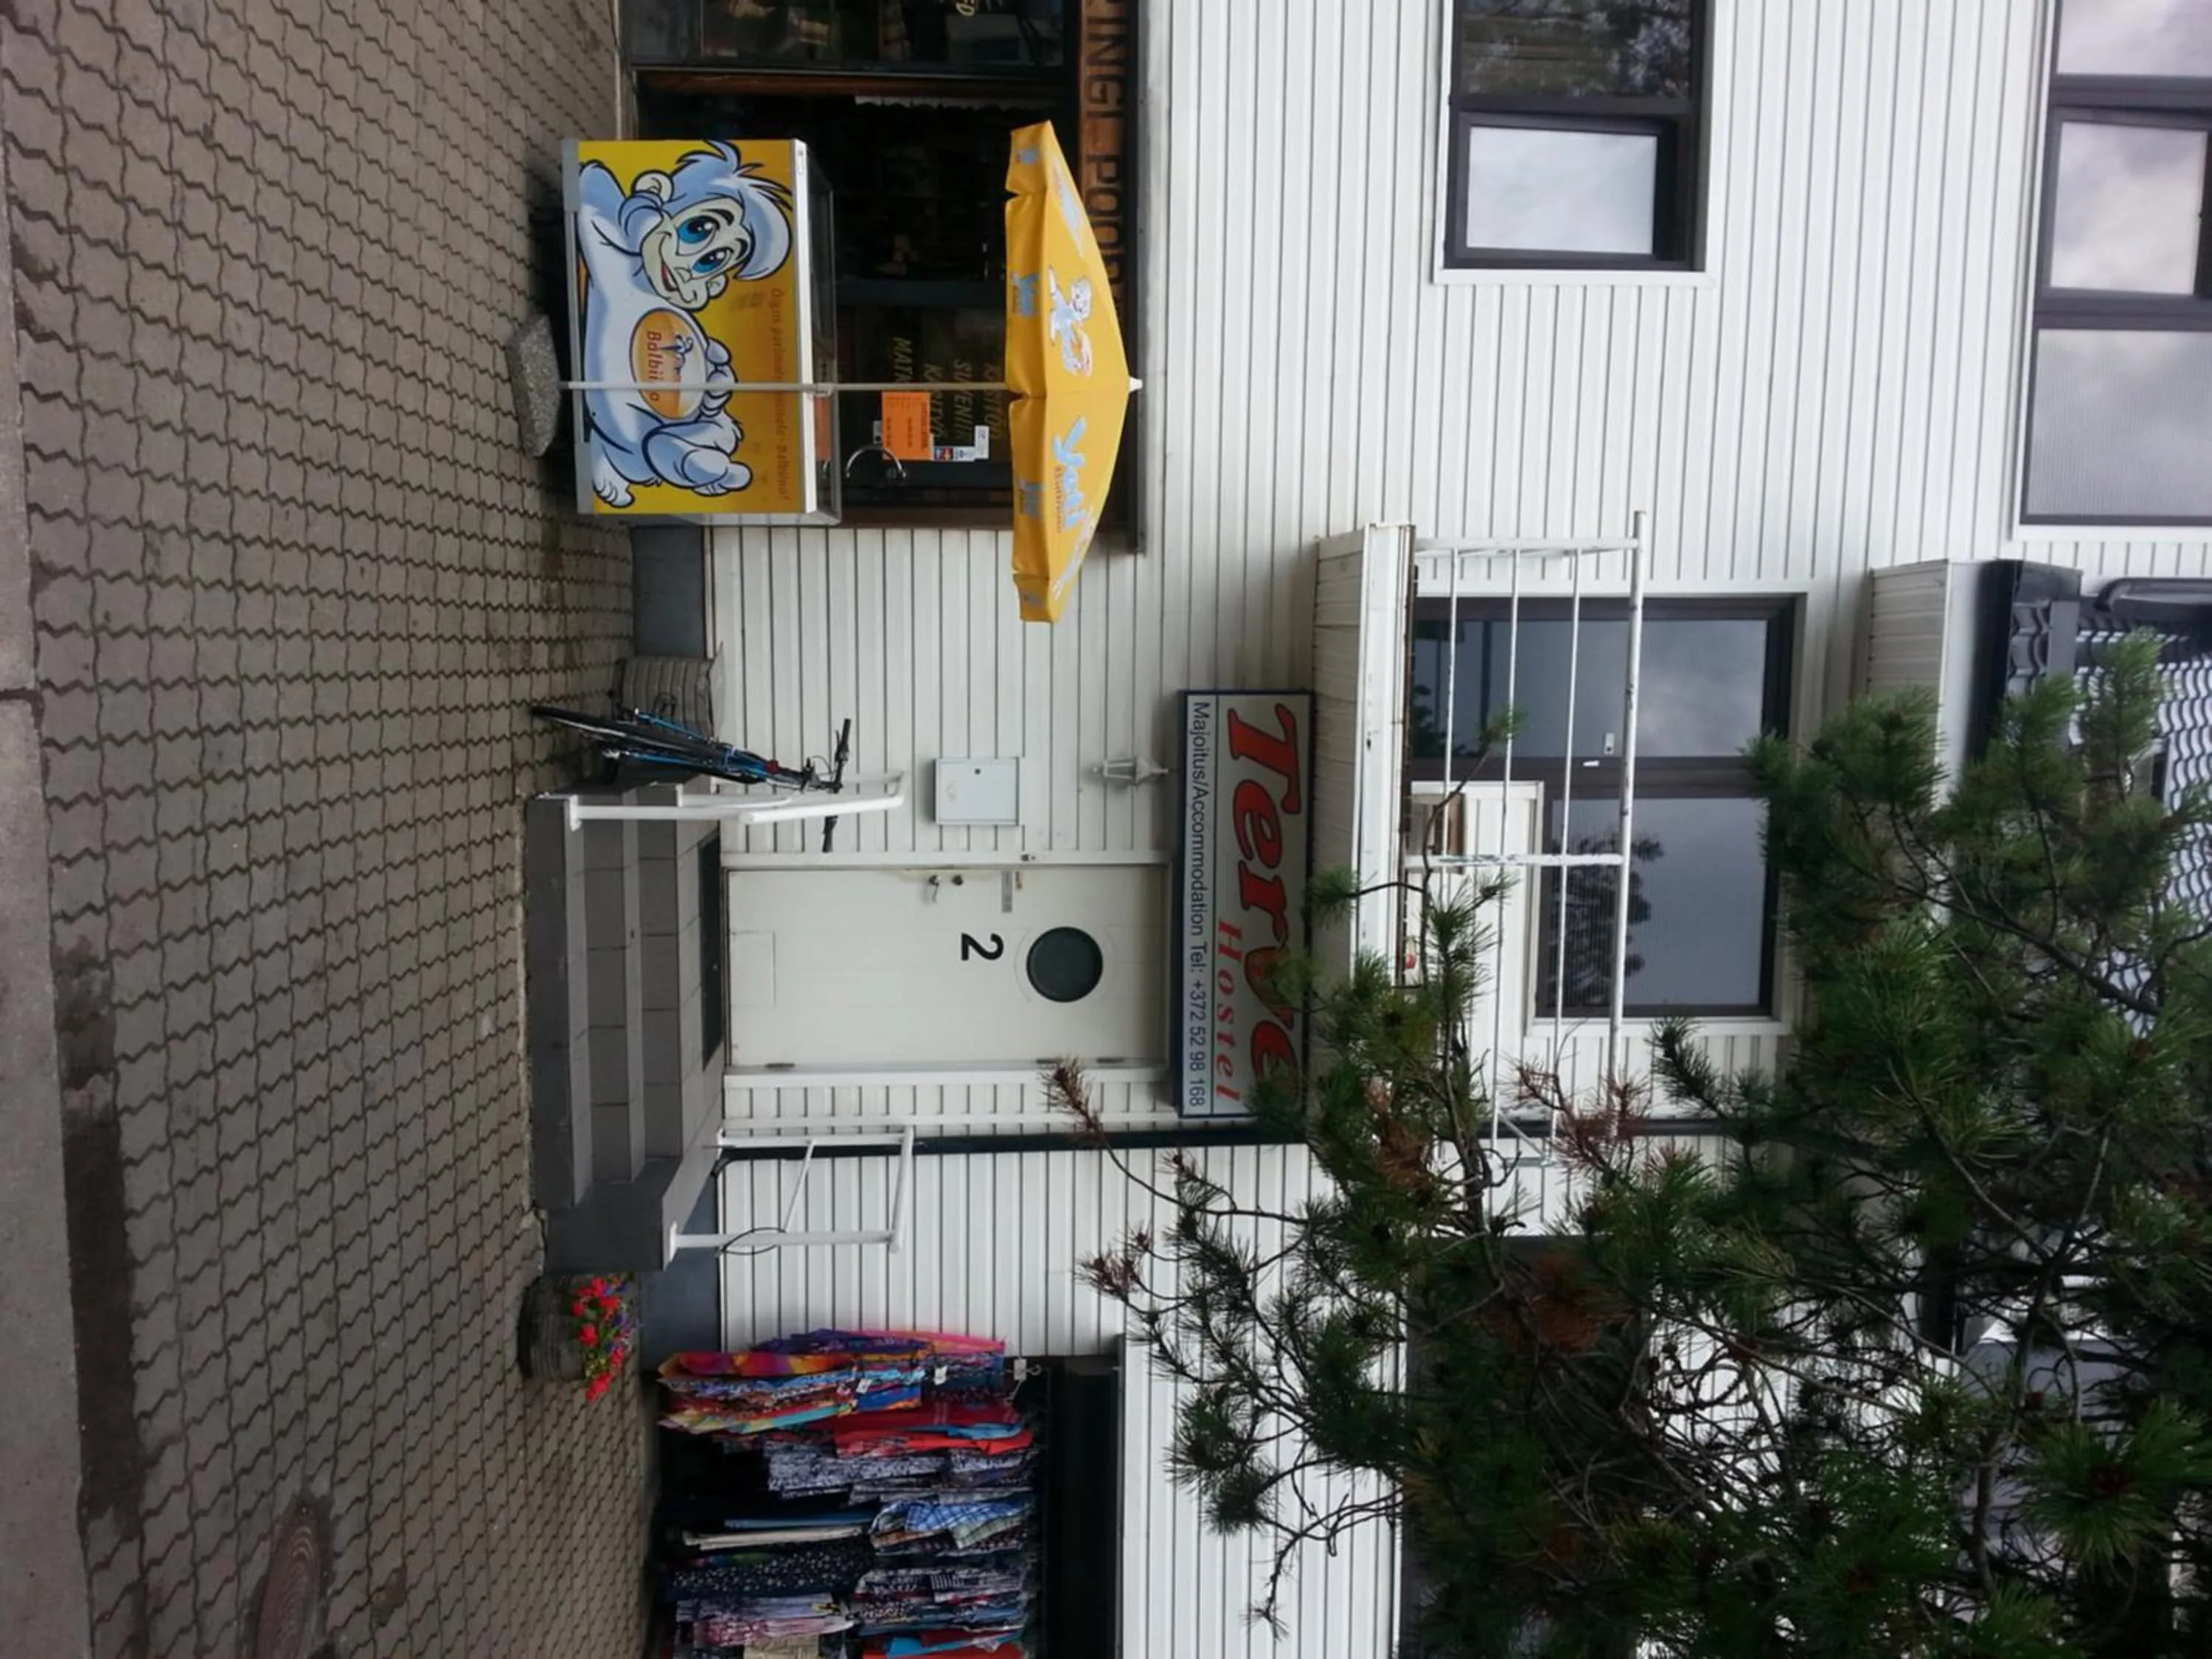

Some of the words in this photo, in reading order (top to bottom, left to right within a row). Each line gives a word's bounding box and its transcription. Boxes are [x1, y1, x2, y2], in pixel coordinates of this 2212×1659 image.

[1085, 0, 1130, 119] INGI
[646, 330, 663, 402] Balbiio
[1190, 702, 1211, 936] Majoitus/Accommodation
[961, 932, 1004, 961] 2
[1190, 942, 1207, 973] Tel:
[1189, 980, 1205, 1021] +372
[1216, 921, 1242, 1101] Hostel
[1189, 1026, 1205, 1048] 52
[1189, 1051, 1205, 1072] 98
[1189, 1078, 1205, 1107] 168
